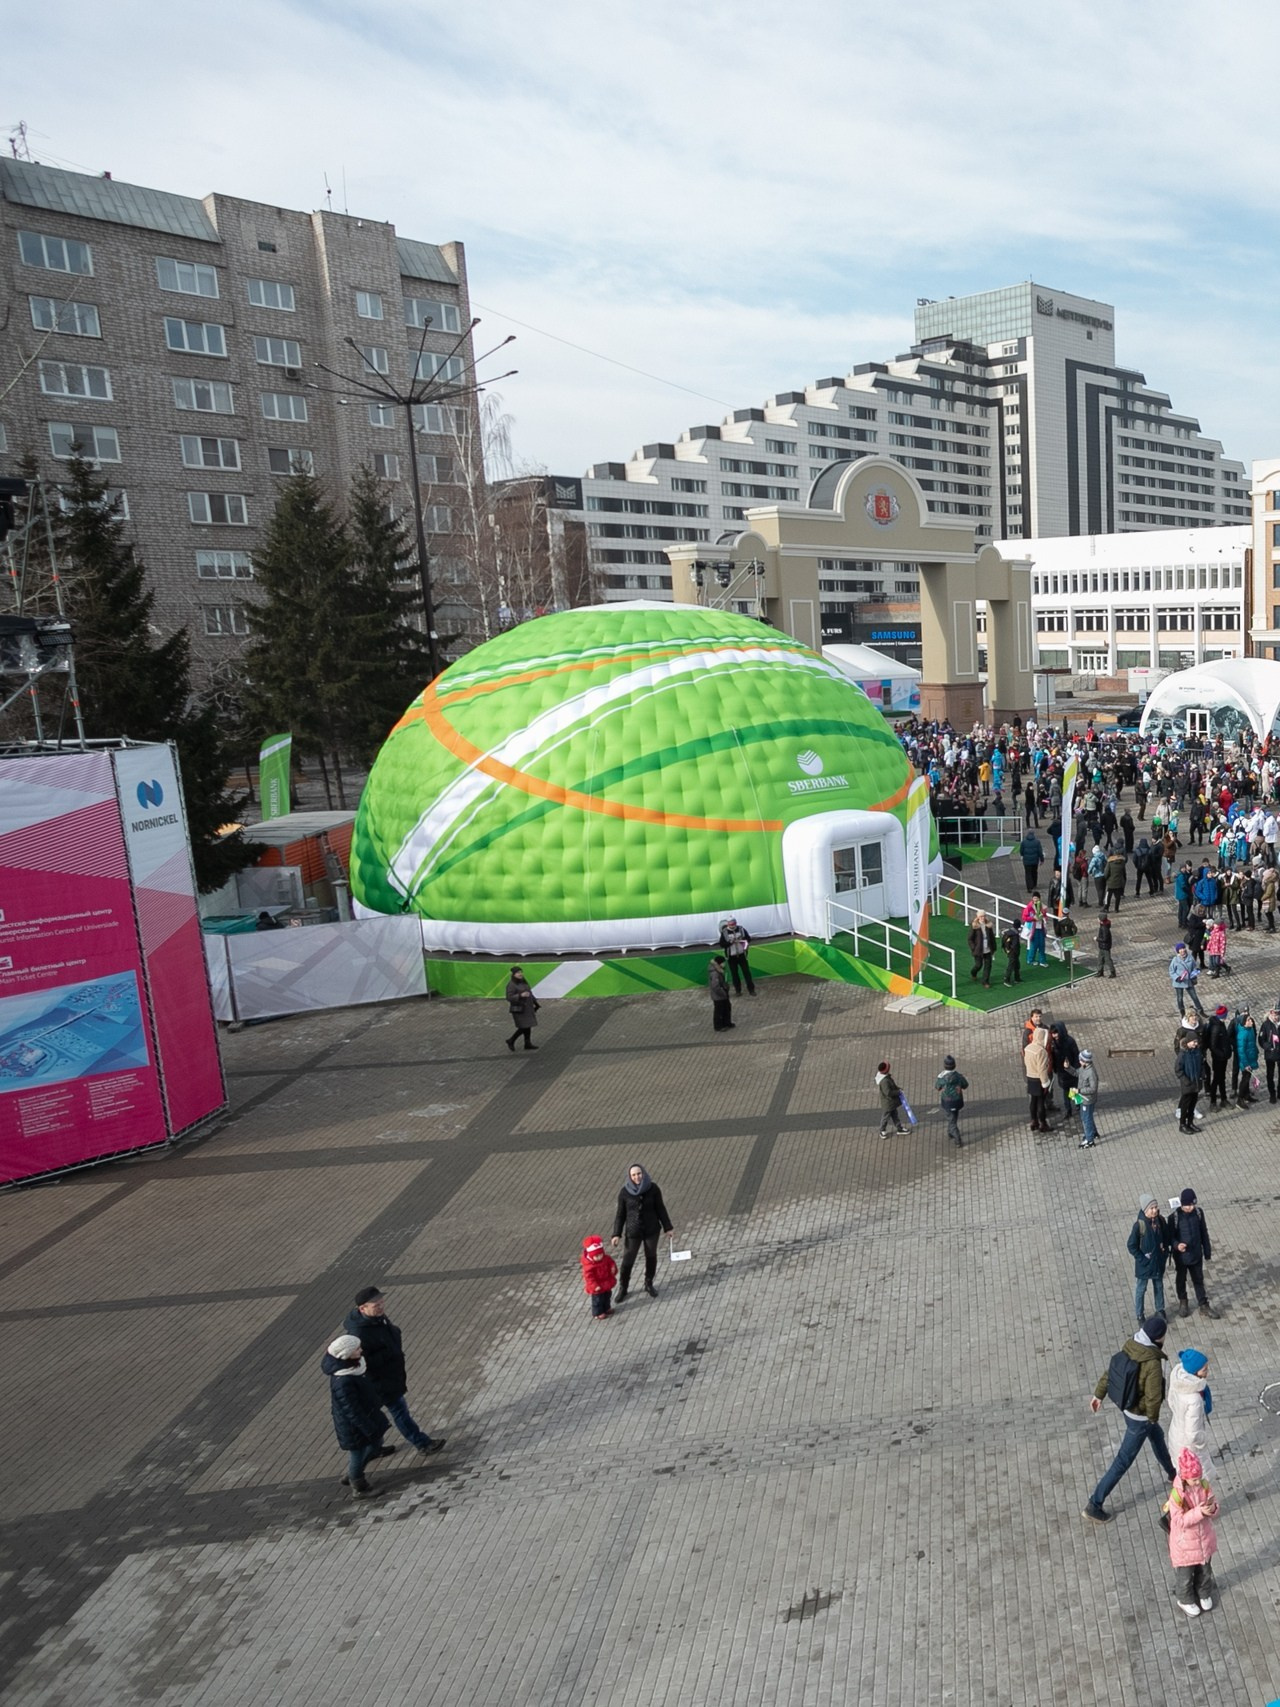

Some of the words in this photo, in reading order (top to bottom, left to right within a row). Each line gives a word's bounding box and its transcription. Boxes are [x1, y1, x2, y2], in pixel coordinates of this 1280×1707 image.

[871, 631, 916, 640] SAMSUNG
[787, 775, 849, 793] SBERBANK
[131, 813, 178, 833] NORNICKEL
[92, 908, 113, 917] центр
[16, 931, 54, 941] Information
[54, 927, 75, 936] Centre
[75, 925, 83, 934] of
[84, 920, 120, 931] Universiade
[30, 961, 65, 972] билетный
[65, 958, 87, 967] центр
[16, 972, 37, 982] Ticket
[37, 970, 58, 979] Centre
